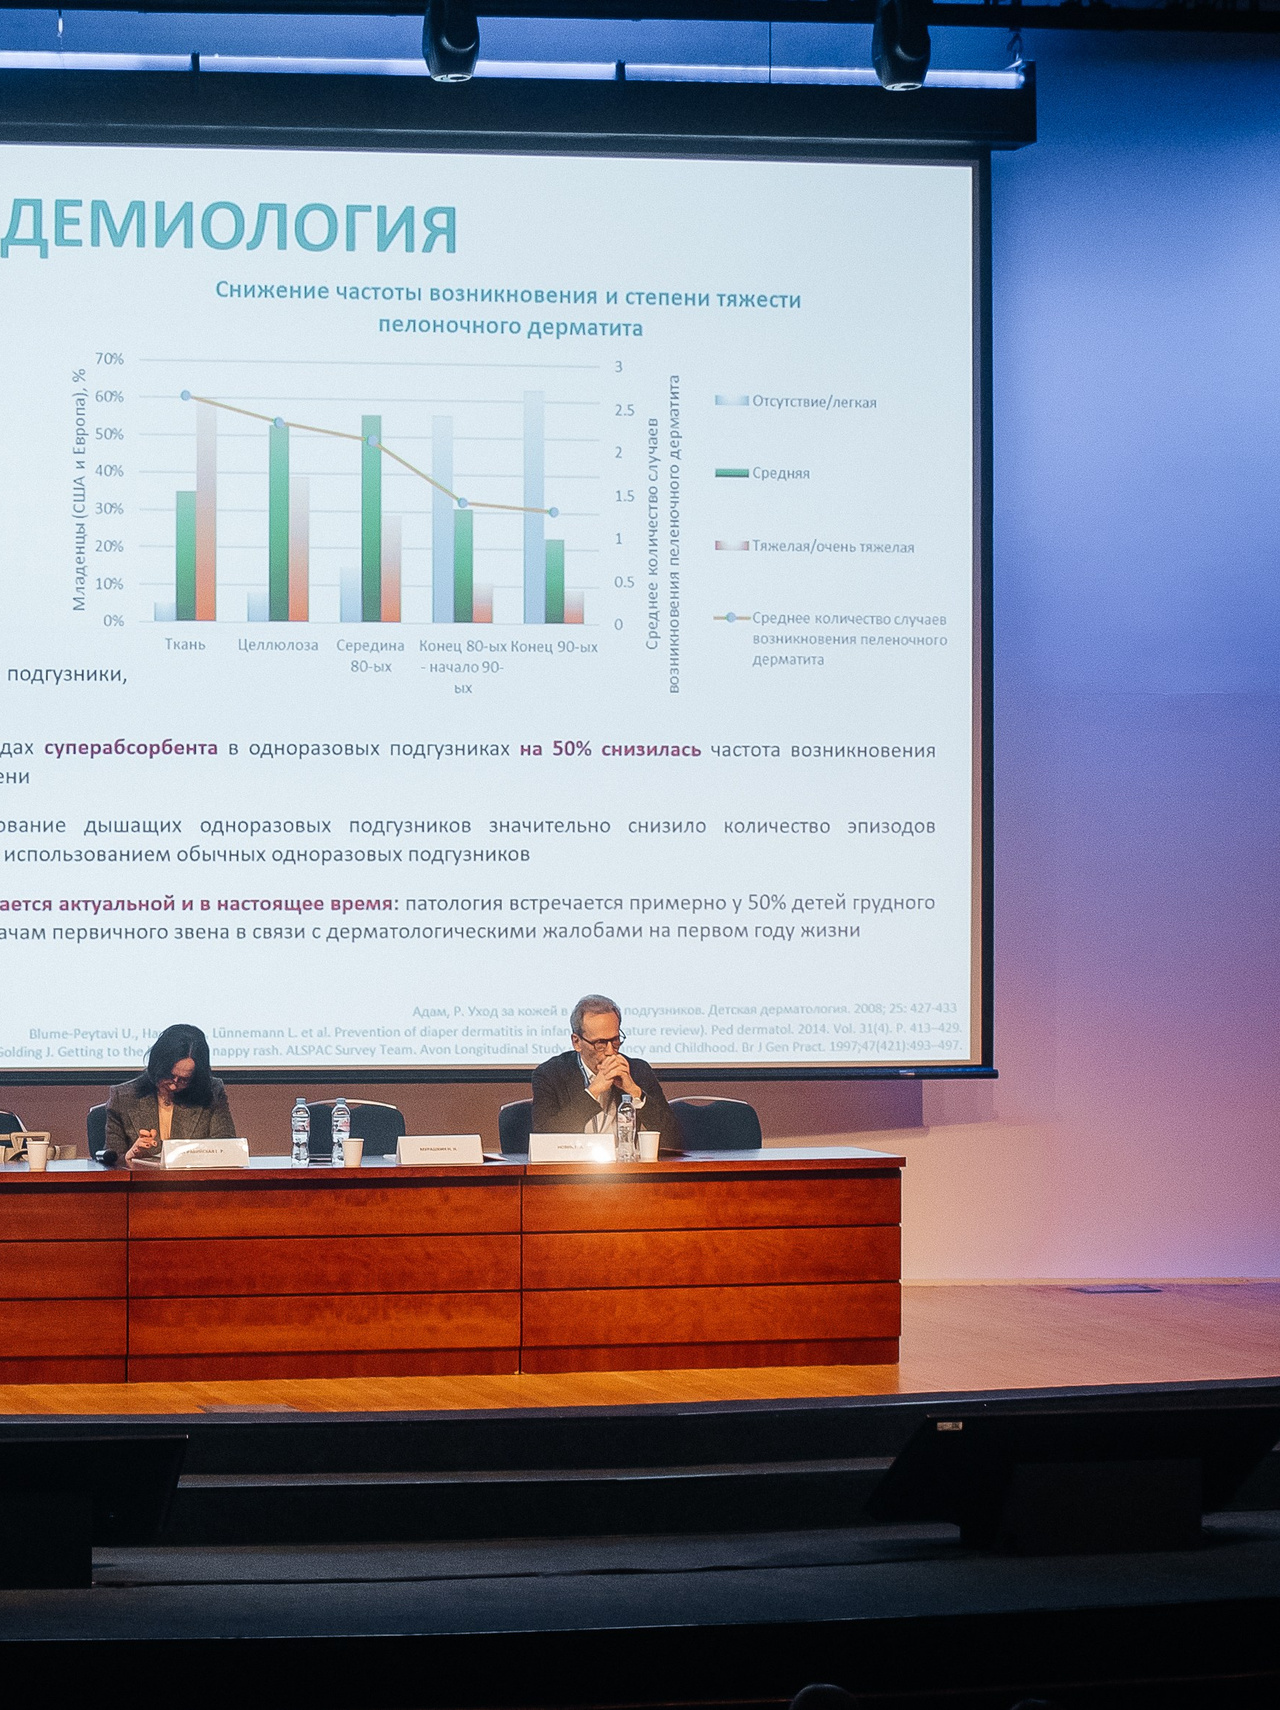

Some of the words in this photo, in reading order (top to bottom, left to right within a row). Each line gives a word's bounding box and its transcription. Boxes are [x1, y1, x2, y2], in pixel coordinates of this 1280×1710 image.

[216, 280, 329, 299] Снижение
[336, 286, 421, 301] частоты
[430, 288, 597, 304] возникновения
[606, 291, 618, 304] и
[625, 291, 709, 306] степени
[717, 293, 801, 308] тяжести
[379, 318, 521, 334] пелоночного
[527, 321, 643, 339] дерматита
[96, 352, 124, 365] 70%
[615, 360, 623, 373] 3
[72, 369, 86, 383] %
[95, 390, 124, 403] 60%
[753, 394, 877, 410] Отсутствие/легкая
[615, 404, 635, 416] 2.5
[72, 388, 89, 454] Европа),
[670, 375, 682, 460] дерматита
[96, 427, 124, 440] 50%
[615, 446, 622, 459] 2
[648, 418, 661, 482] случаев
[76, 460, 85, 469] и
[95, 464, 124, 477] 40%
[753, 466, 810, 481] Средняя
[72, 476, 88, 519] (США
[616, 490, 635, 502] 1.5
[96, 502, 124, 515] 30%
[670, 464, 680, 566] пеленочного
[648, 486, 658, 575] количество
[616, 532, 622, 545] 1
[95, 540, 124, 552] 20%
[753, 539, 856, 554] Тяжелая/очень
[860, 543, 914, 553] тяжелая
[72, 523, 87, 611] Младенцы
[96, 577, 124, 590] 10%
[614, 576, 635, 588] 0.5
[103, 614, 124, 627] 0%
[646, 582, 661, 650] Среднее
[752, 611, 810, 626] Среднее
[815, 615, 891, 625] количество
[894, 616, 947, 627] случаев
[614, 618, 623, 631] 0
[670, 572, 679, 693] возникновения
[165, 638, 206, 650] Ткань
[238, 638, 318, 653] Целлюлоза
[336, 639, 404, 653] Середина
[420, 640, 462, 654] Конец
[466, 640, 507, 652] 80-ых
[511, 640, 553, 654] Конец
[557, 641, 598, 653] 90-ых
[753, 635, 856, 645] возникновения
[861, 636, 948, 646] пеленочного
[351, 660, 391, 673] 80-ых
[430, 663, 479, 673] начало
[482, 661, 504, 673] 90-
[752, 655, 824, 667] дерматита
[8, 669, 127, 685] подгузники,
[454, 685, 472, 694] ых
[83, 820, 181, 836] дышащих
[200, 820, 331, 837] одноразовых
[350, 821, 471, 837] подгузников
[490, 821, 611, 833] значительно
[628, 821, 706, 833] снизило
[725, 821, 830, 833] количество
[848, 822, 935, 836] эпизодов
[5, 850, 170, 862] использованием
[177, 845, 266, 862] обычных
[272, 850, 402, 866] одноразовых
[409, 849, 530, 865] подгузников
[412, 1006, 450, 1019] Адам,
[454, 1006, 464, 1016] Р.
[468, 1006, 499, 1019] Уход
[502, 1008, 514, 1016] за
[518, 1005, 557, 1016] кожей
[46, 1047, 53, 1057] J.
[57, 1046, 103, 1059] Getting
[107, 1047, 120, 1057] to
[123, 1046, 146, 1060] the
[212, 1048, 250, 1058] nappy
[253, 1045, 282, 1056] rash.
[286, 1045, 332, 1056] ALSPAC
[335, 1045, 376, 1057] Survey
[380, 1044, 417, 1055] Team.
[420, 1044, 451, 1055] Avon
[455, 1043, 528, 1057] Longitudinal
